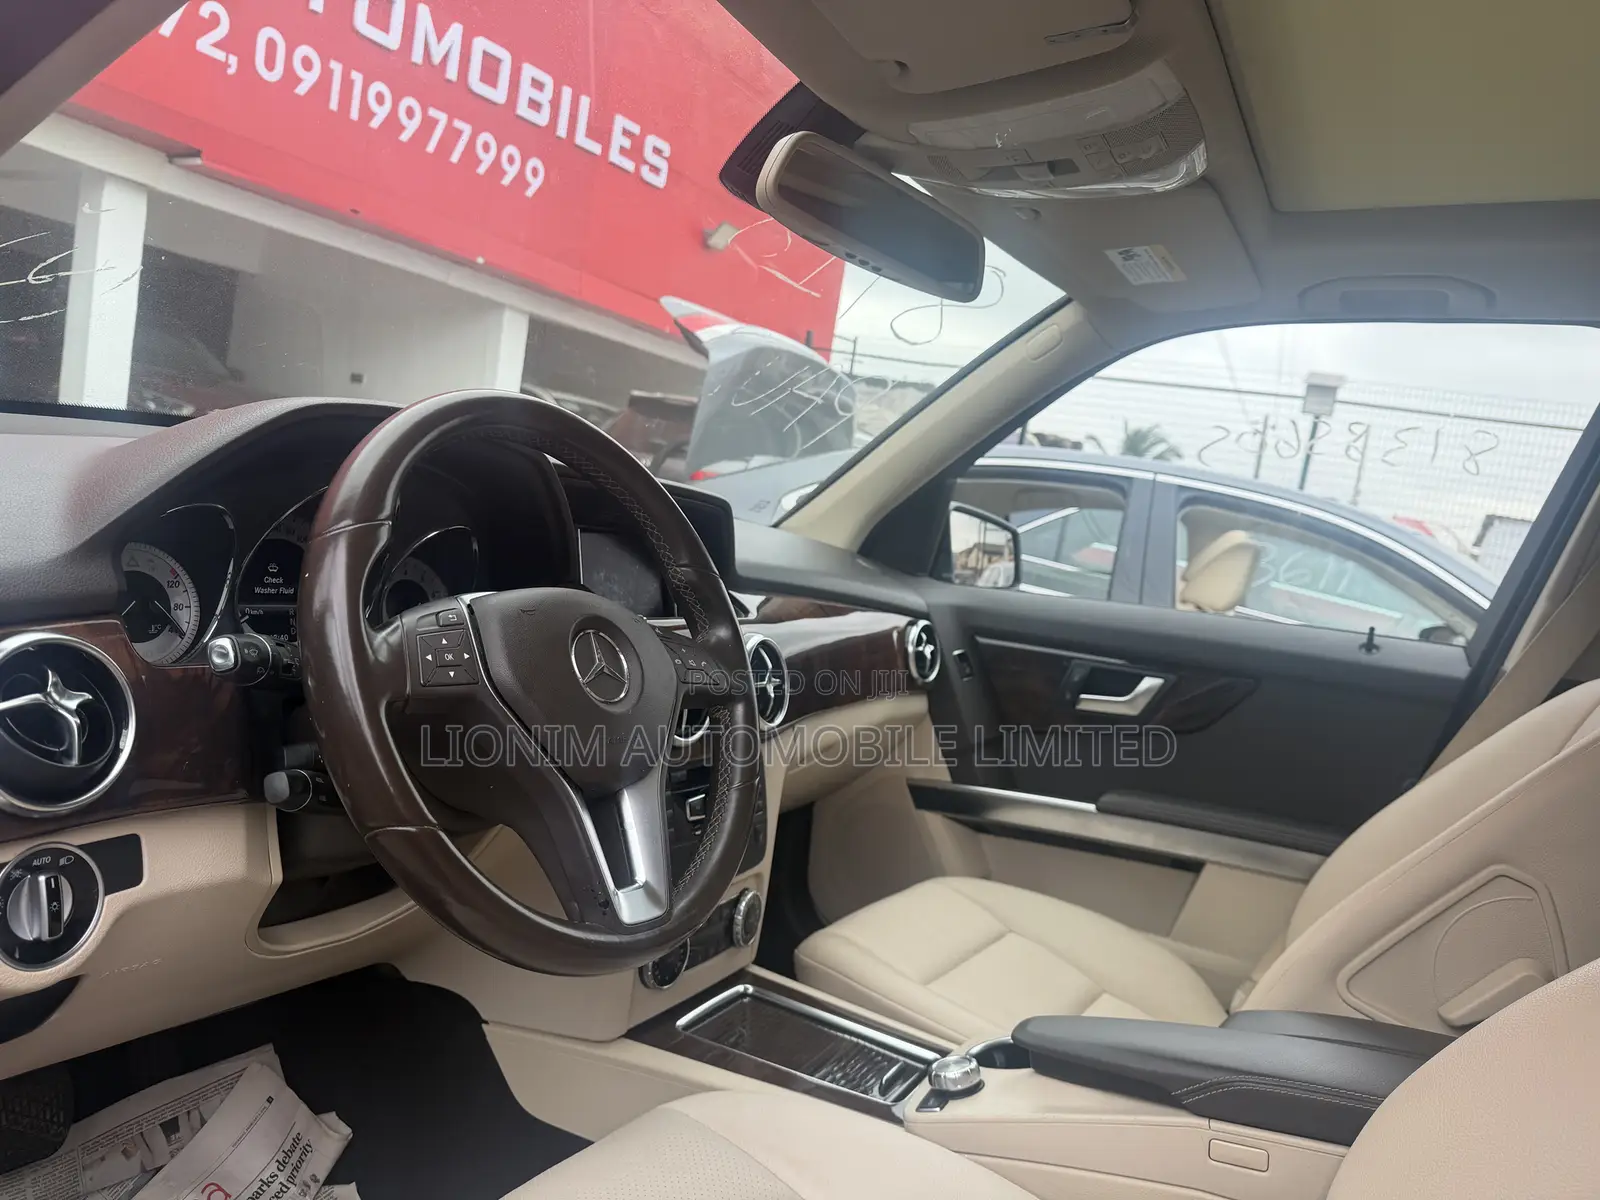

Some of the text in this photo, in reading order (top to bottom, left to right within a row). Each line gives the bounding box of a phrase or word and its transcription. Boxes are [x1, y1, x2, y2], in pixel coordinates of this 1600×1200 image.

[308, 0, 671, 189] OMOBILES
[254, 26, 546, 197] 09119977999
[166, 580, 180, 588] 120
[263, 576, 284, 584] Check
[254, 586, 295, 594] Washer Fluid
[173, 603, 184, 611] 80
[290, 618, 296, 626] N
[444, 653, 455, 661] OK
[32, 856, 52, 867] AUTO
[275, 1131, 303, 1173] debate
[286, 1139, 315, 1187] priority
